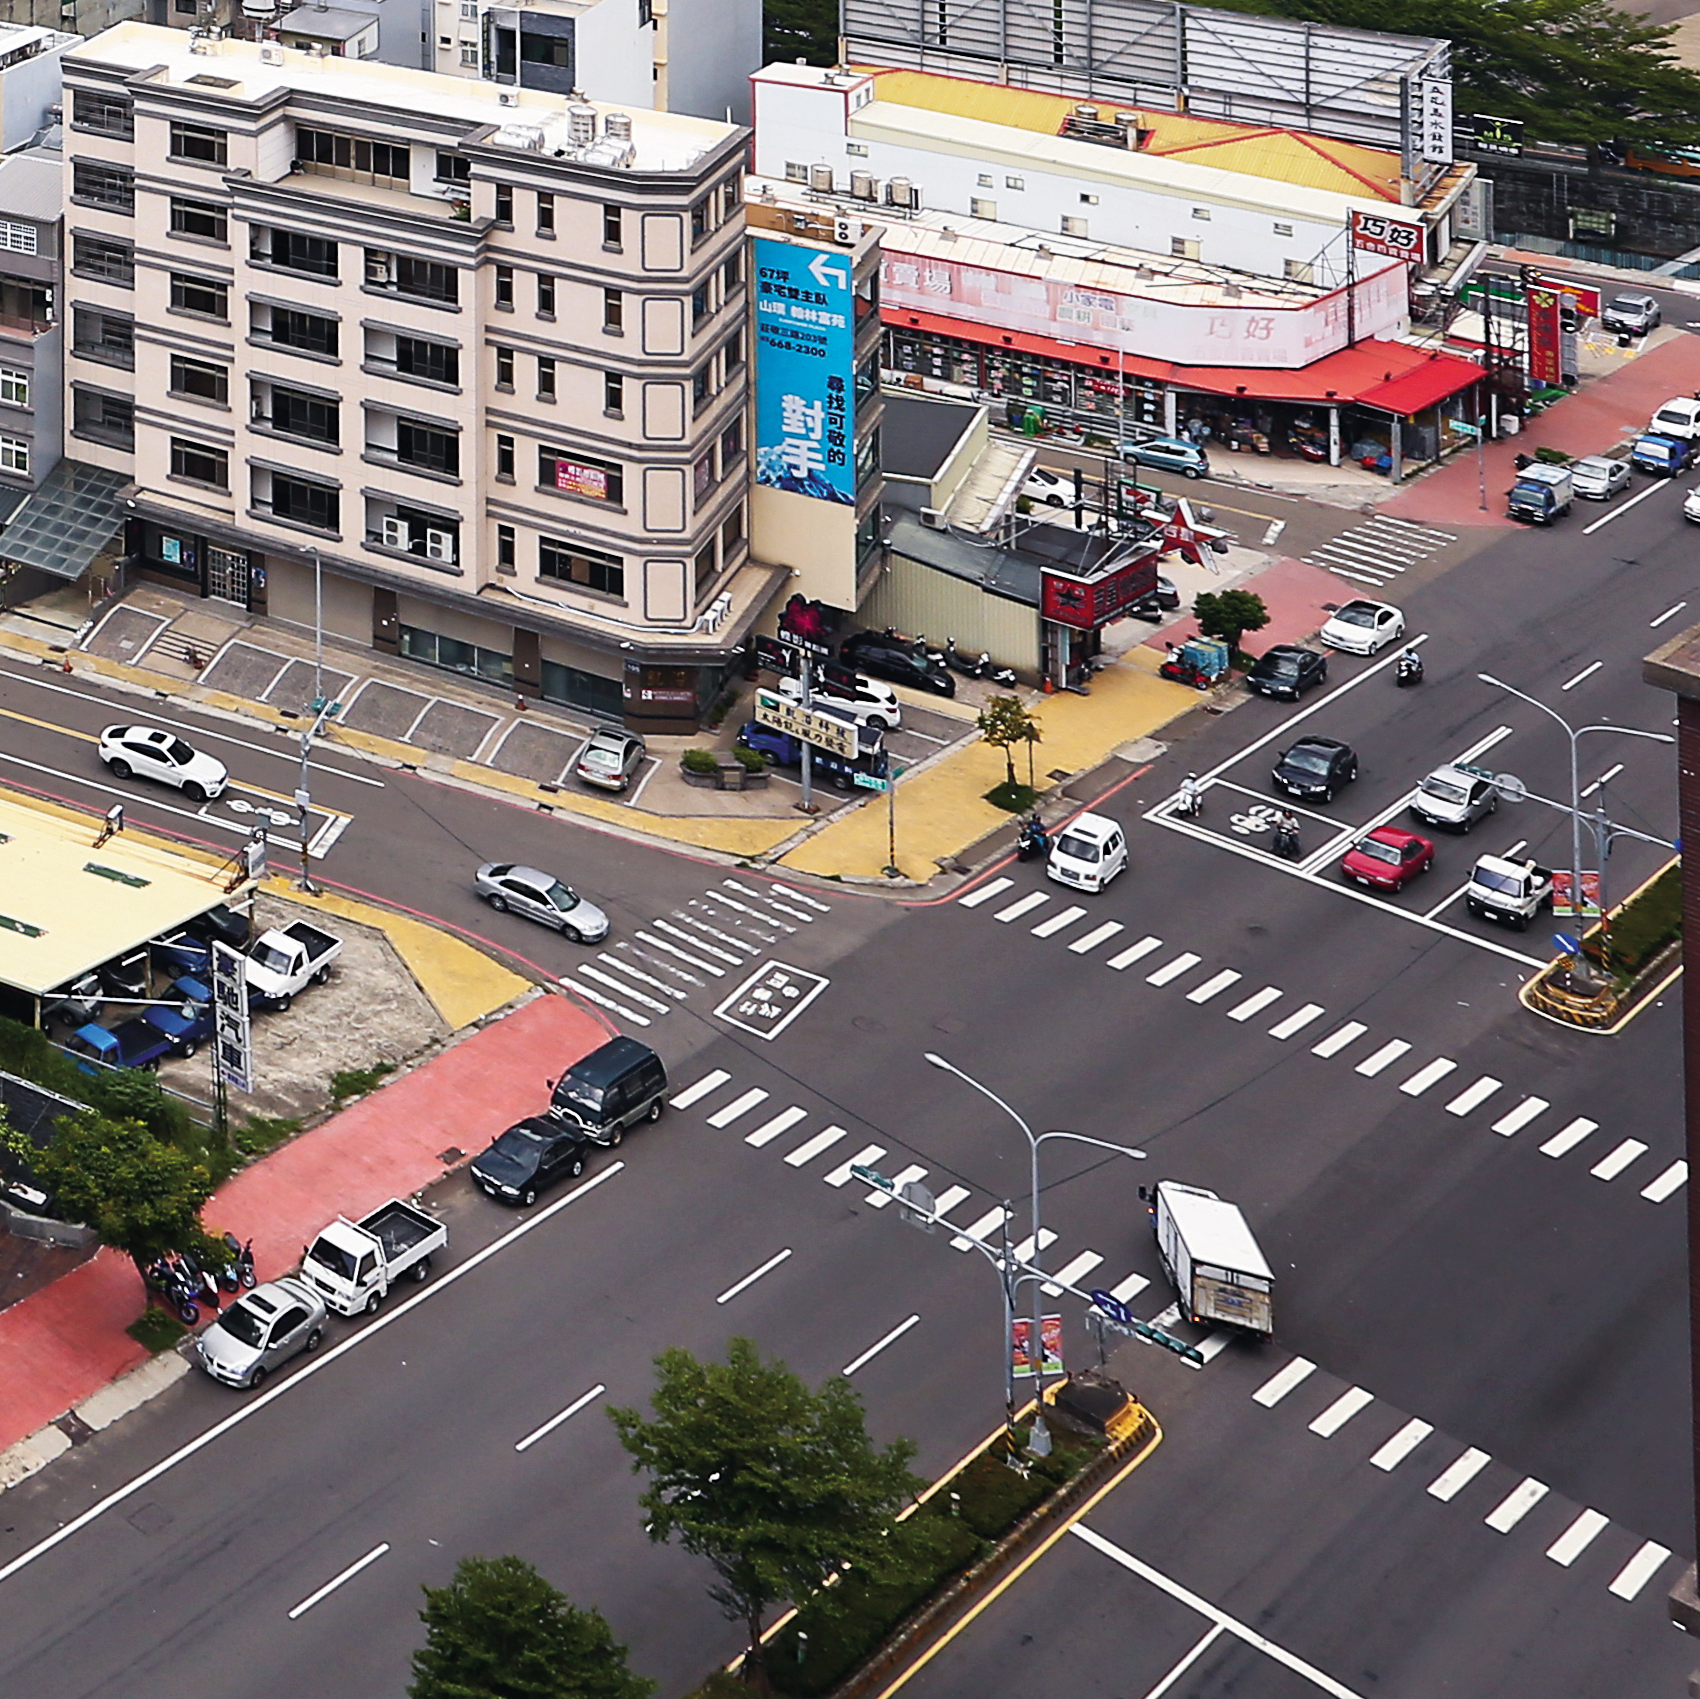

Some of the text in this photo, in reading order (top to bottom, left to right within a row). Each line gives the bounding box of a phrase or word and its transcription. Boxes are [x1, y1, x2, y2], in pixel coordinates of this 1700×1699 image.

[1359, 216, 1415, 247] 巧好
[759, 267, 789, 282] 67坪
[880, 259, 952, 294] 賣場
[769, 337, 826, 358] 668-2300
[781, 394, 826, 479] 對手
[826, 374, 846, 467] 尋找可敬的
